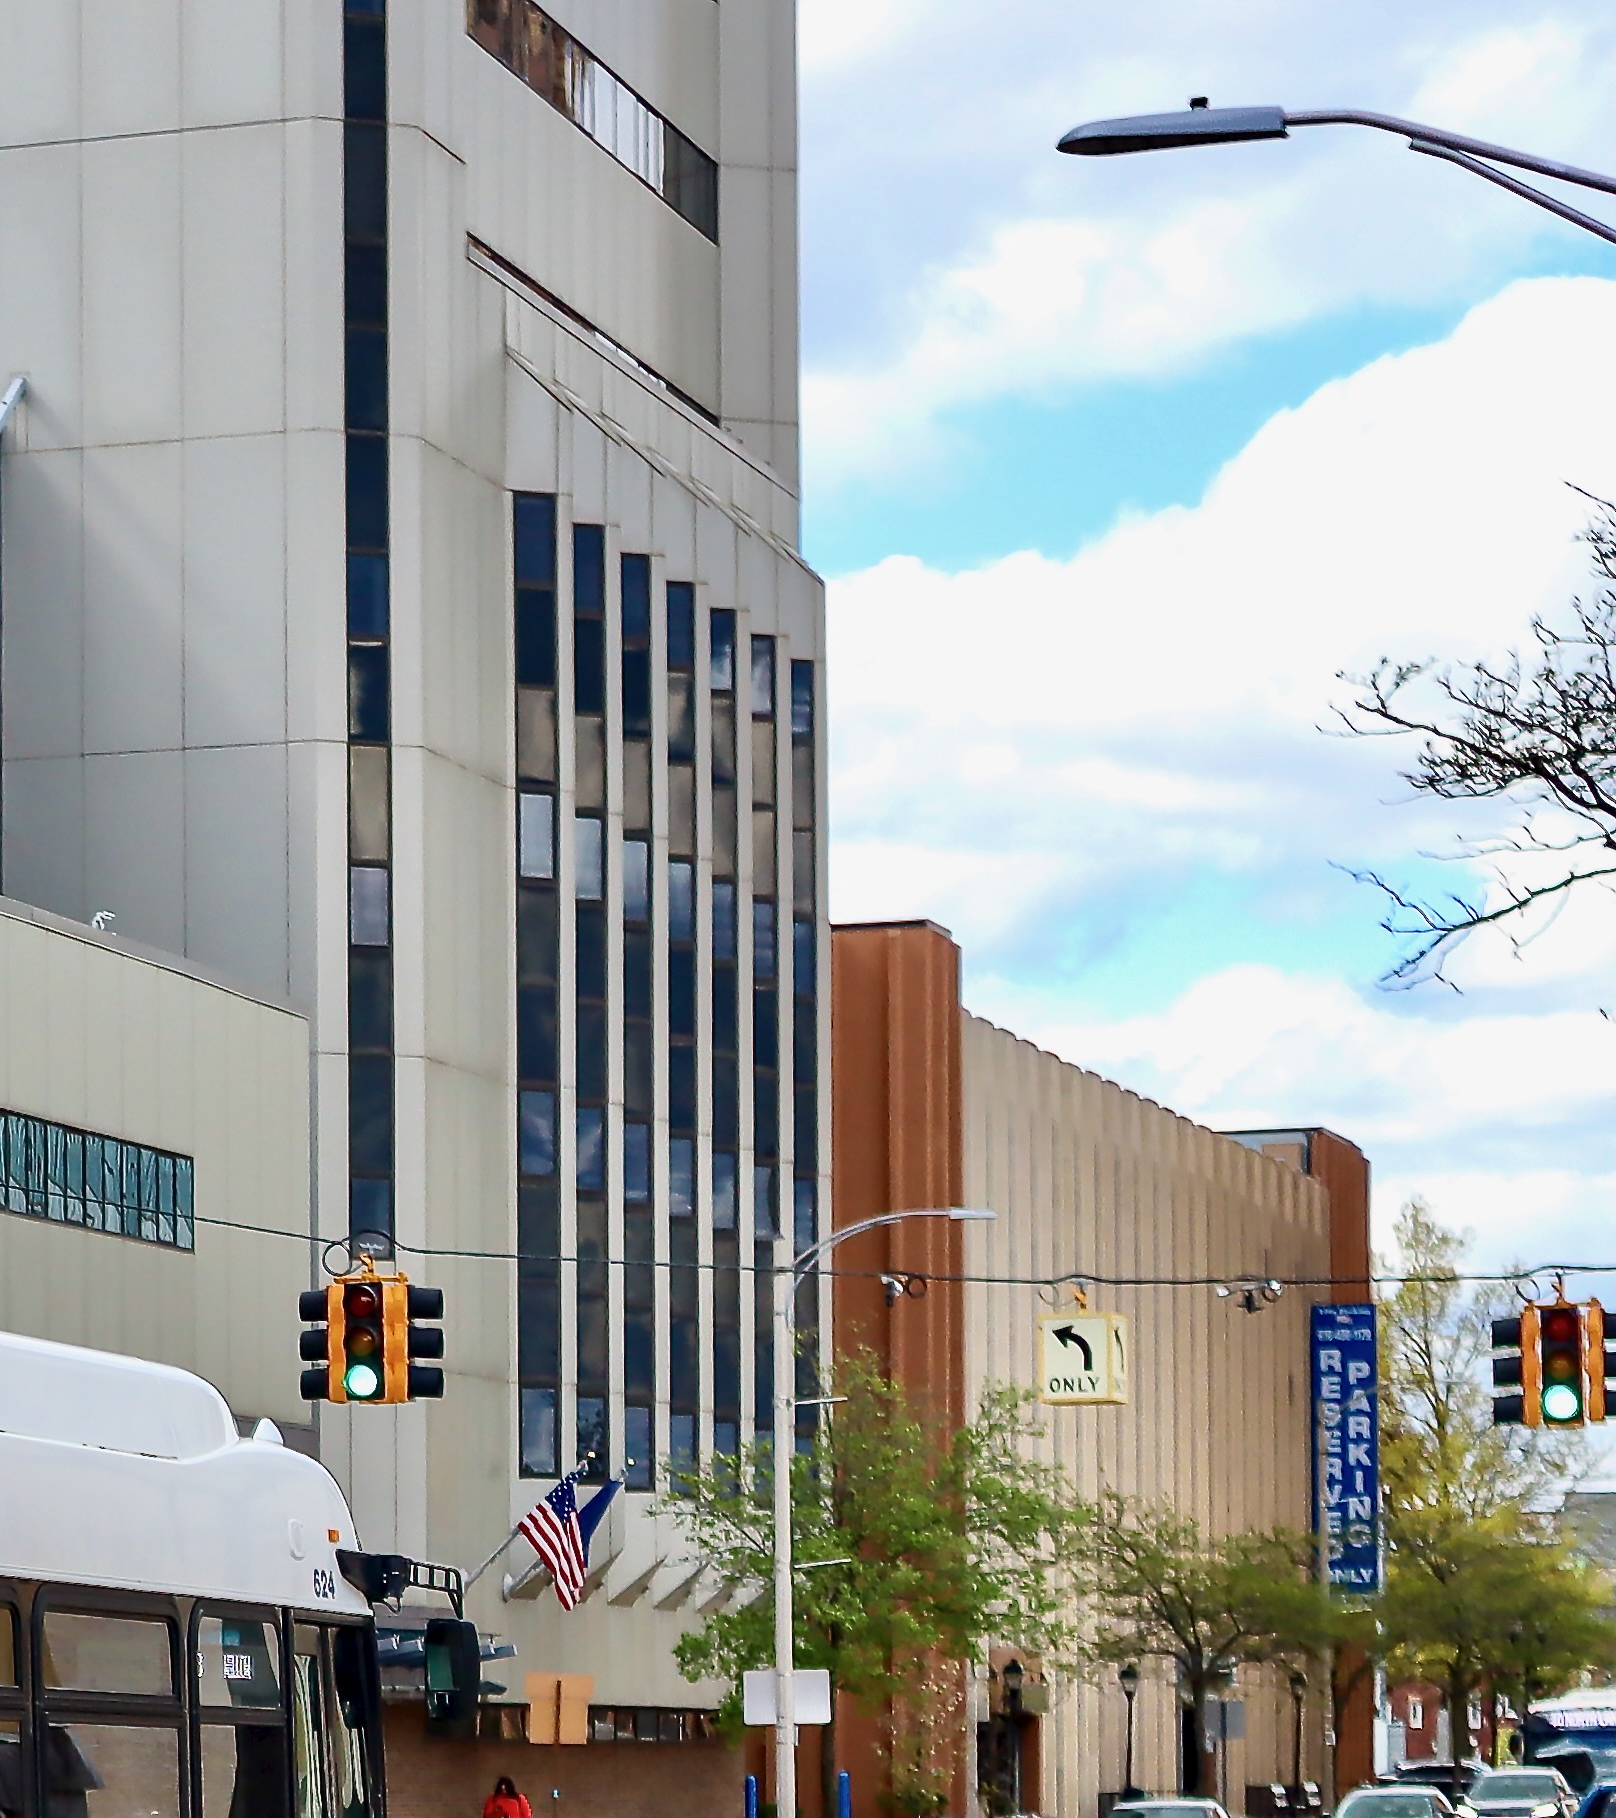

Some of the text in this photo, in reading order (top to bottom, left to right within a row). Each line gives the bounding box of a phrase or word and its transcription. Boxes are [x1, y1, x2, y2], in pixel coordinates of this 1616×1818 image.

[1049, 1375, 1101, 1394] ONLY
[1348, 1361, 1372, 1549] PARKING
[313, 1568, 335, 1600] 624
[1328, 1568, 1374, 1584] NLY
